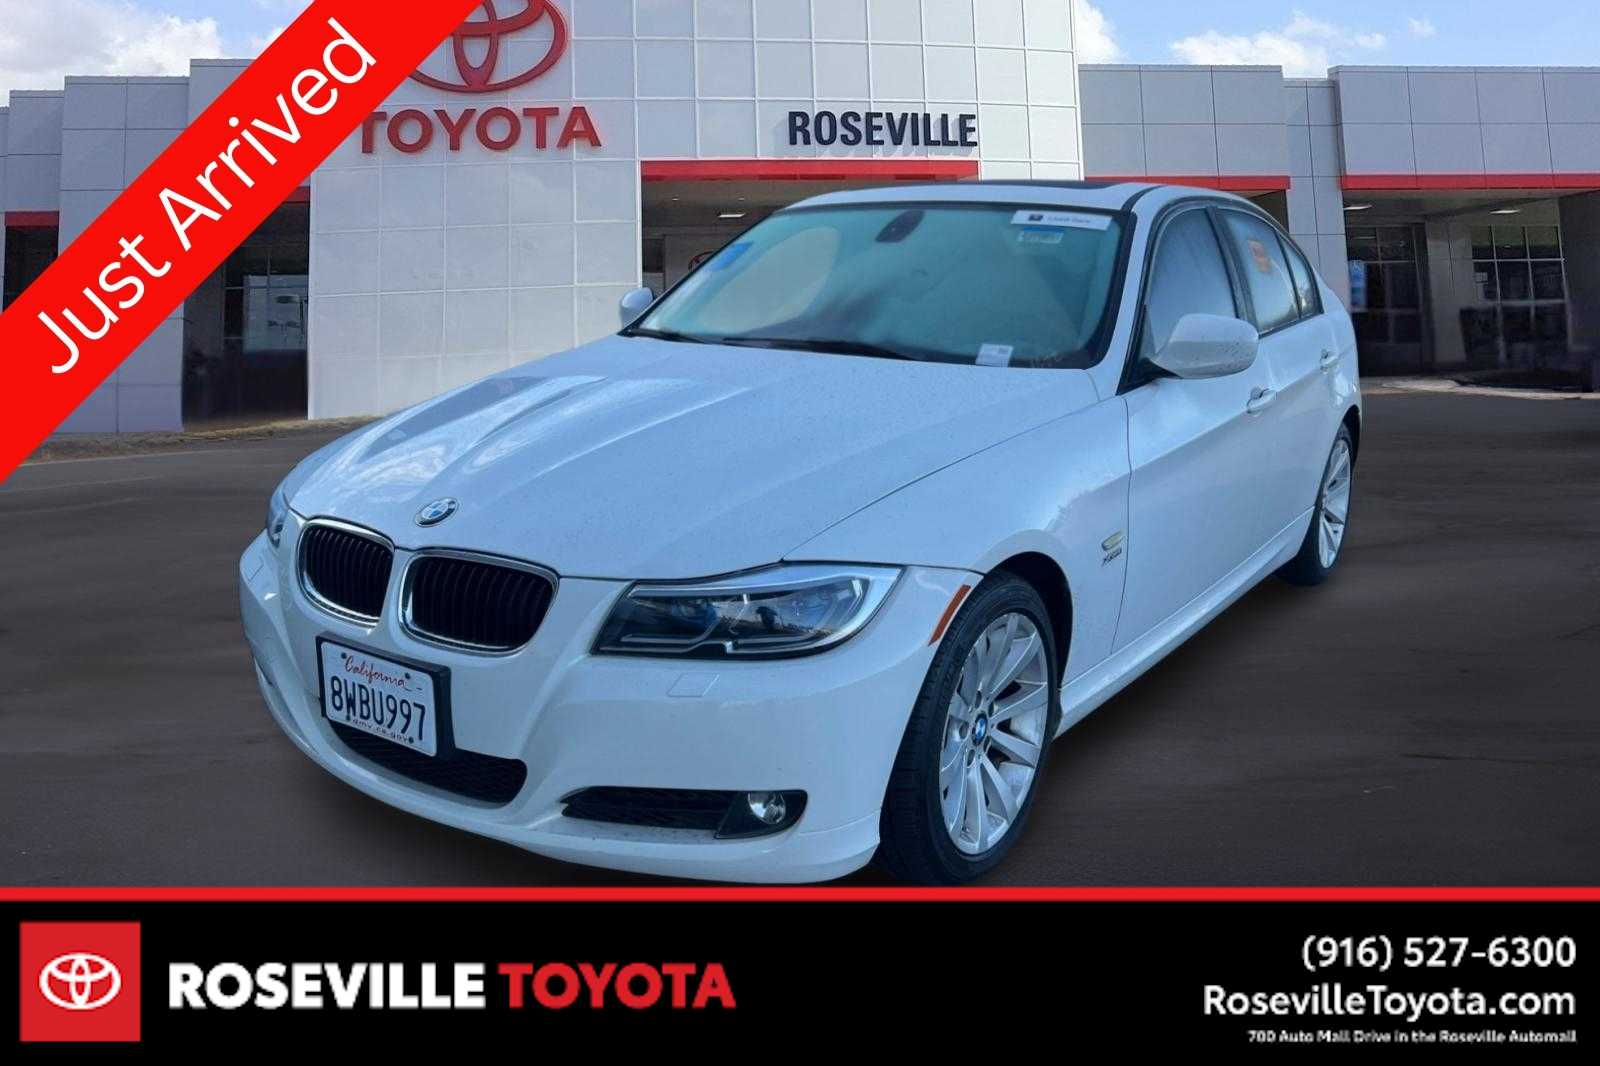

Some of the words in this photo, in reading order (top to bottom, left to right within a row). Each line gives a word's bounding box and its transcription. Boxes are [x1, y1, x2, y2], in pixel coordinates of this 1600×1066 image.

[361, 106, 601, 154] TOYOTA
[789, 111, 978, 147] ROSEVILLE
[345, 656, 410, 691] California
[331, 676, 426, 741] 8WBU997
